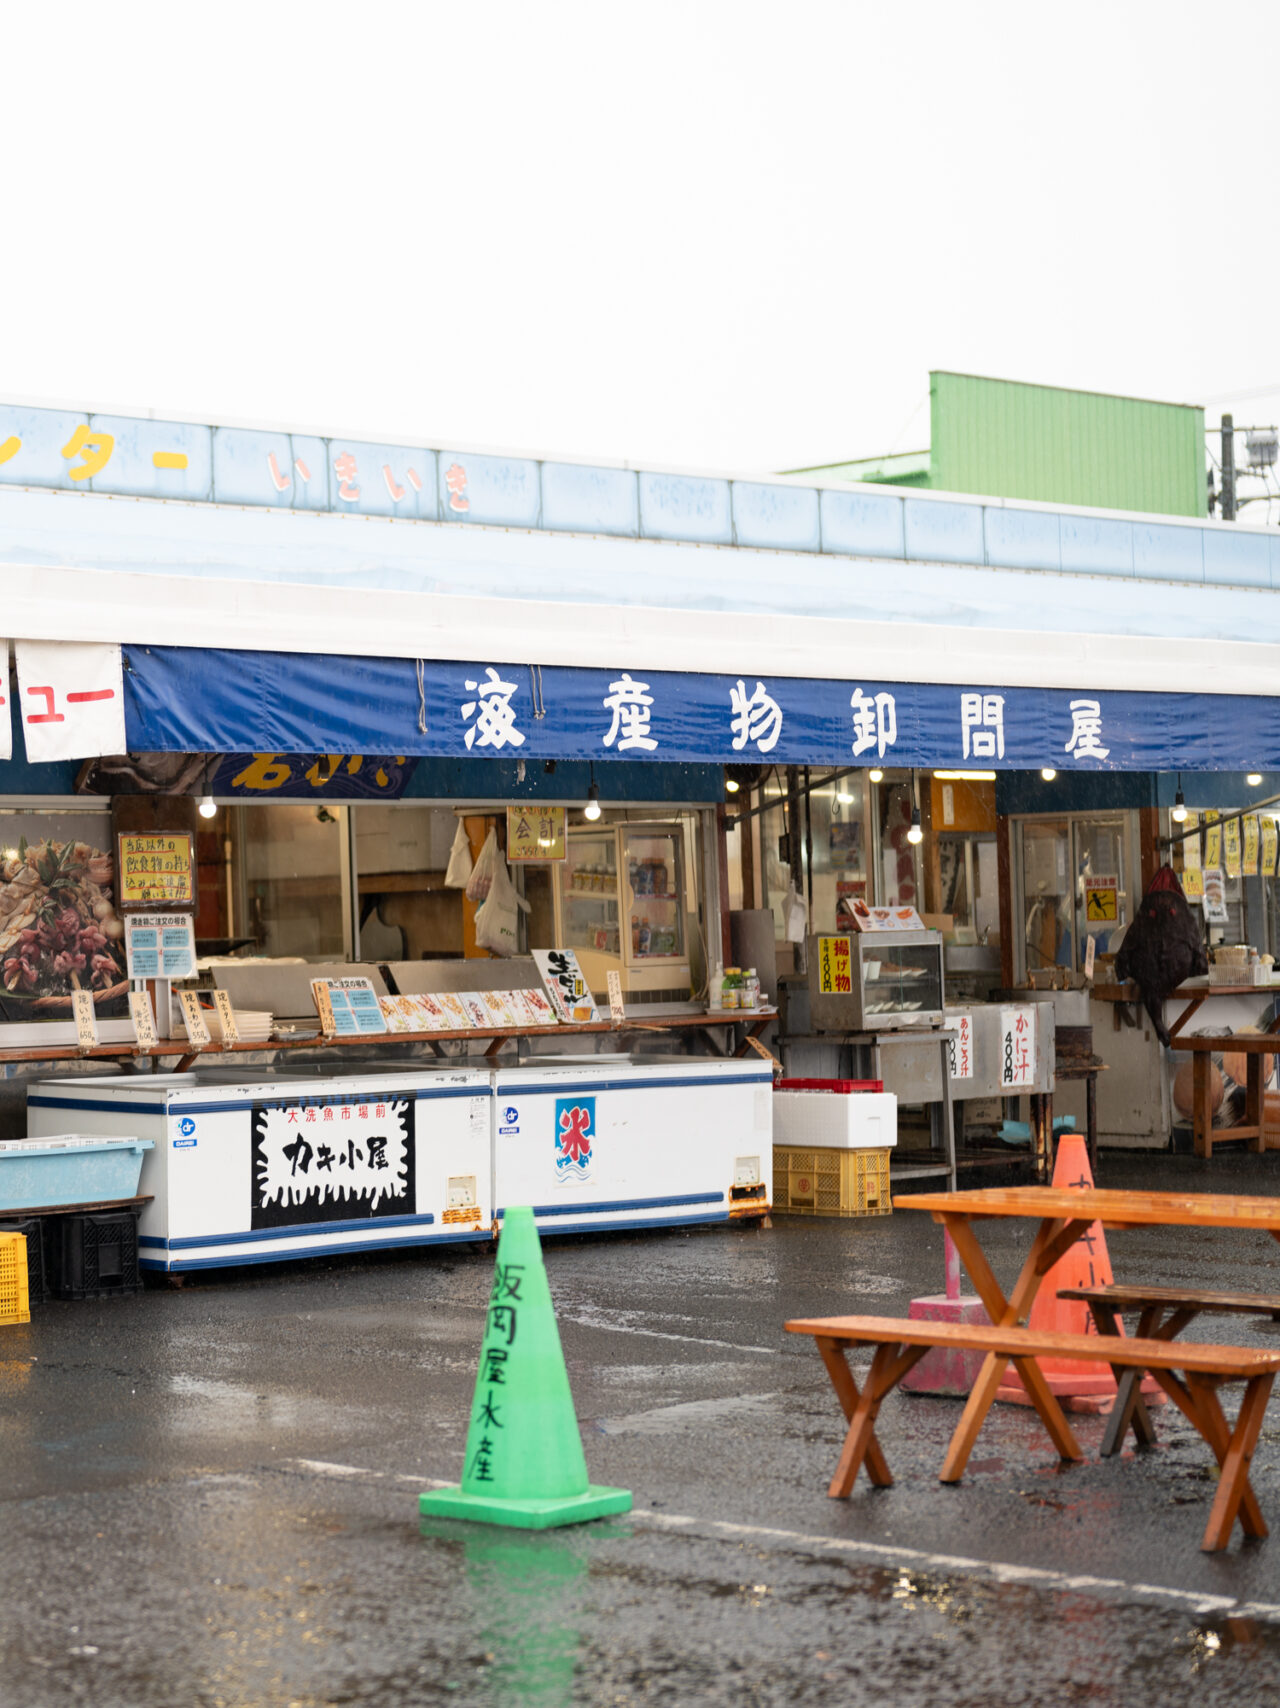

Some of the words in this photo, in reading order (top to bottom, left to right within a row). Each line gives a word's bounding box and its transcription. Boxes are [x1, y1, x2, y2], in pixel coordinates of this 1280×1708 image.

[268, 451, 470, 513] いきいき
[461, 666, 1110, 760] 海産物卸問屋
[126, 838, 175, 852] 当店以外の
[126, 855, 189, 872] 飲食物の持ち
[823, 953, 832, 992] 400円
[834, 940, 850, 992] 揚げ物
[949, 1038, 957, 1075] 00円
[960, 1018, 969, 1076] あんこう汁
[1004, 1030, 1013, 1082] 400円
[1014, 1013, 1030, 1082] かに汁
[288, 1105, 386, 1123] 大洗魚市場前
[559, 1106, 590, 1162] 氷
[282, 1133, 390, 1177] カキ小屋
[468, 1263, 526, 1482] 飯岡屋水産
